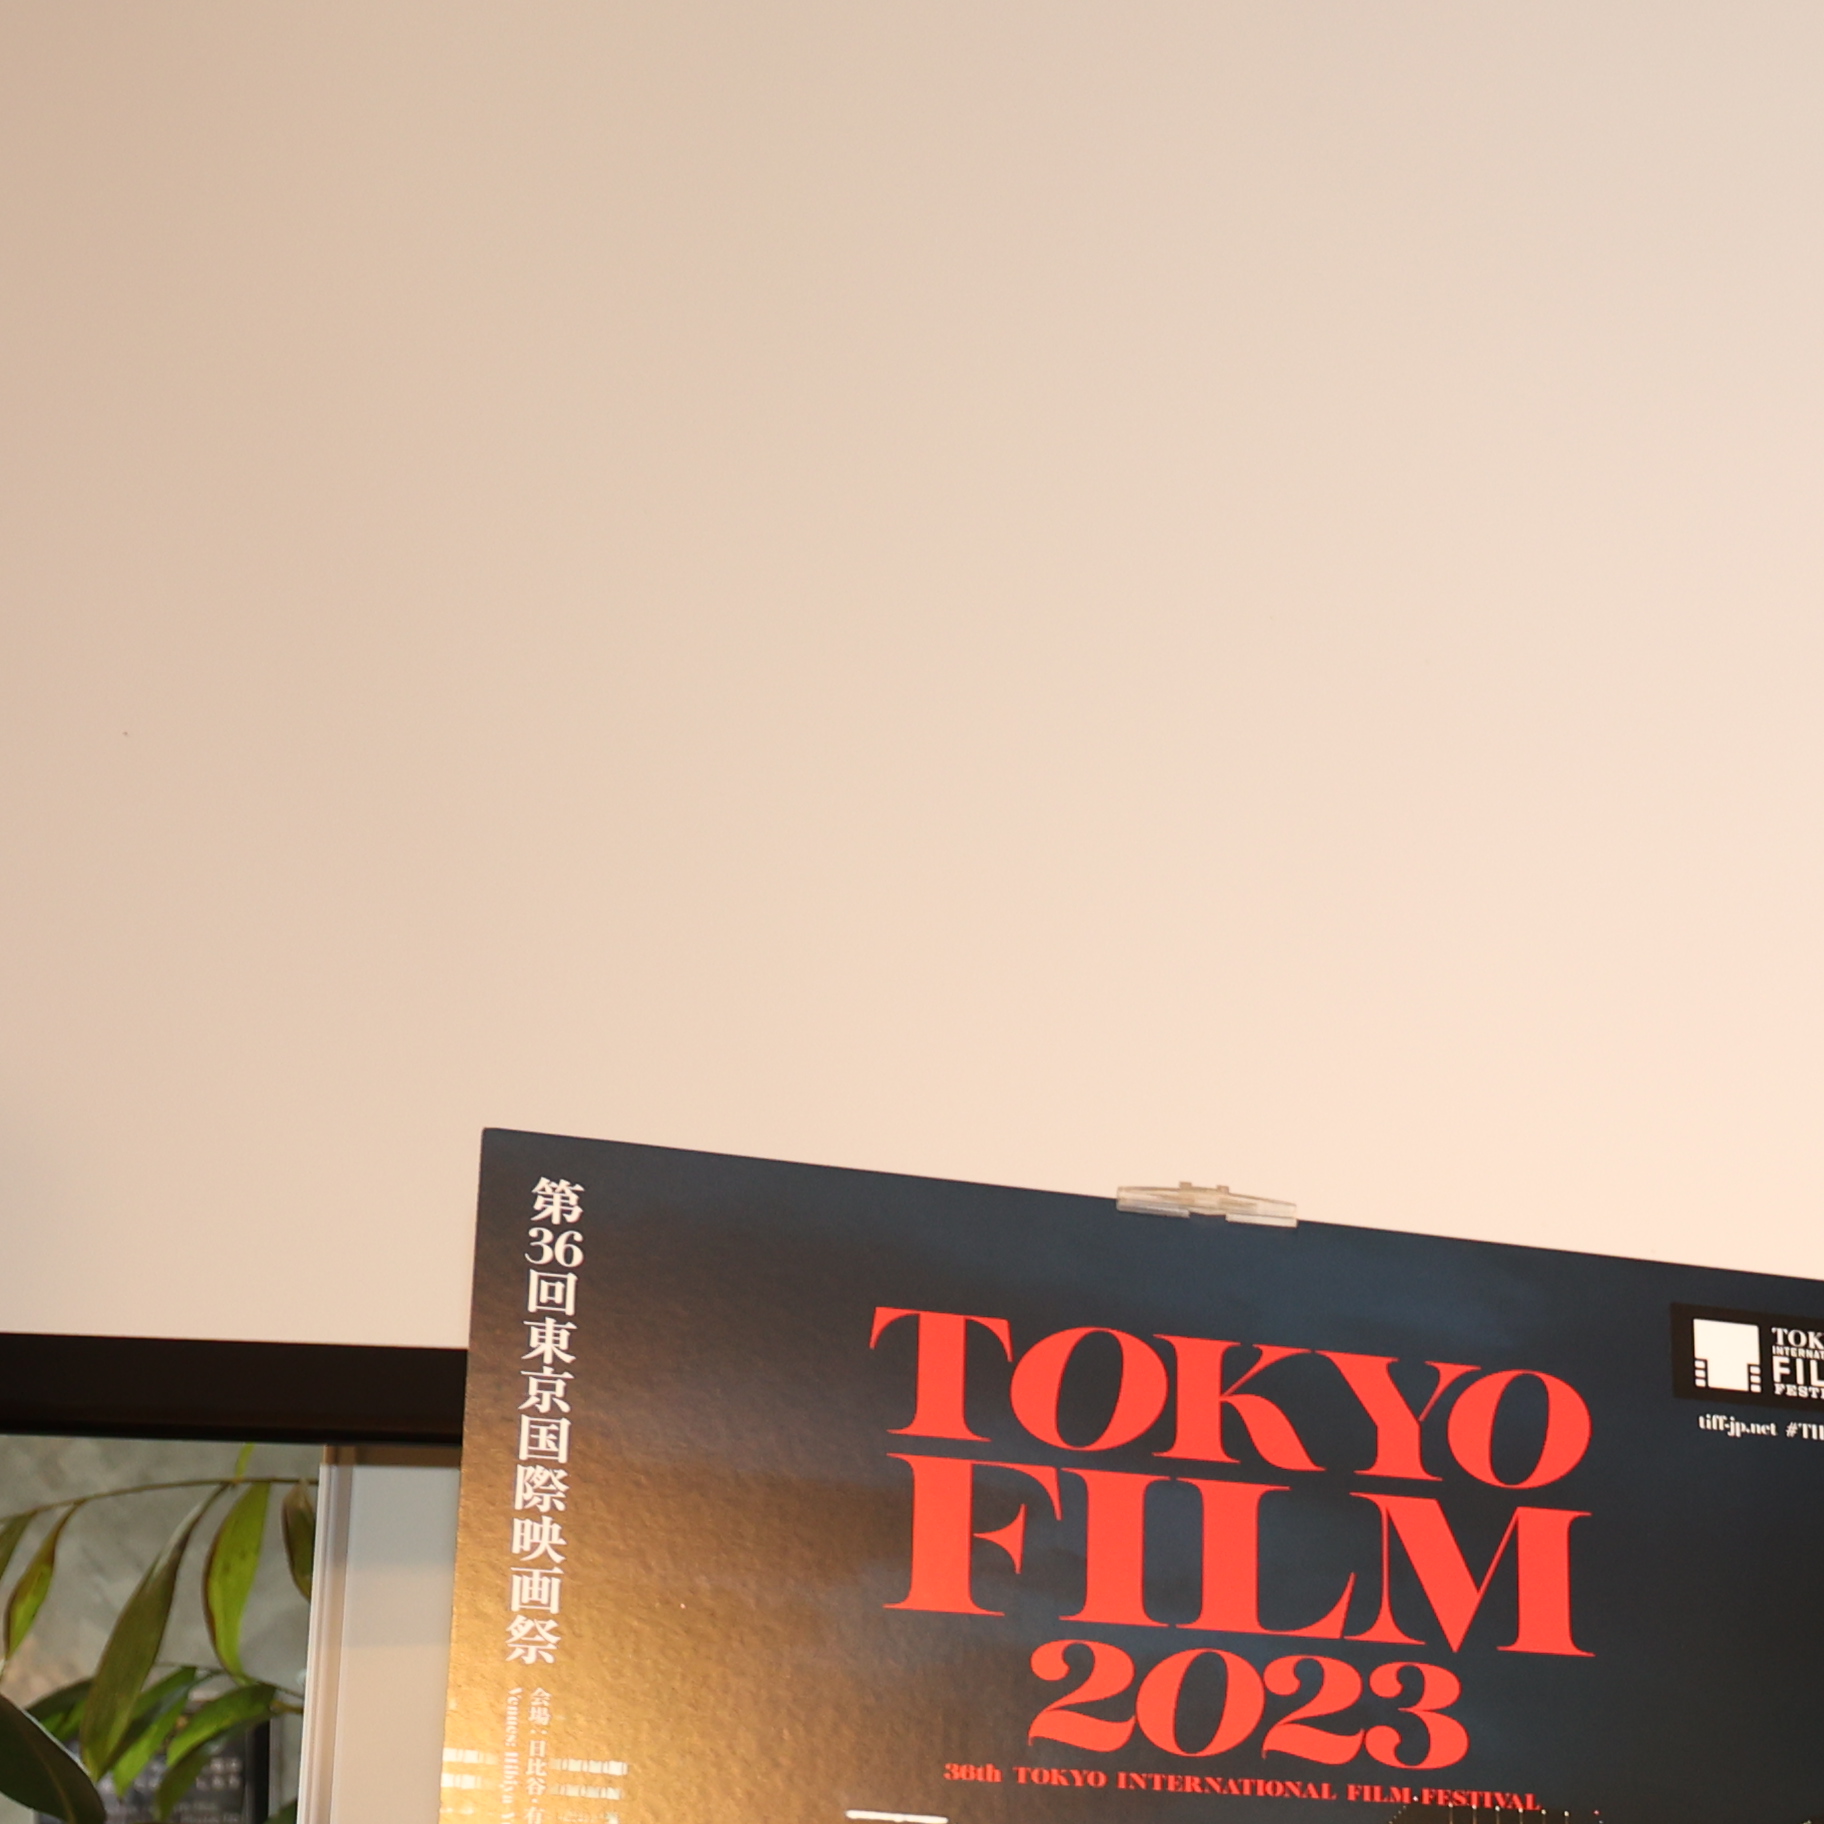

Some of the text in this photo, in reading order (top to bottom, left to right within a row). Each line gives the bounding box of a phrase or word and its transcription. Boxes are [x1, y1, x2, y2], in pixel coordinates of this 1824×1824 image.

[505, 1176, 584, 1665] 第36回東京国際映画祭
[869, 1306, 1593, 1490] TOKYO
[1698, 1413, 1778, 1438] tiff-jp.net
[883, 1453, 1596, 1658] FILM
[1028, 1638, 1470, 1771] 2023
[944, 1762, 1541, 1811] 36th TOKYO INTERNATIONAL FILM FESTIVAL
